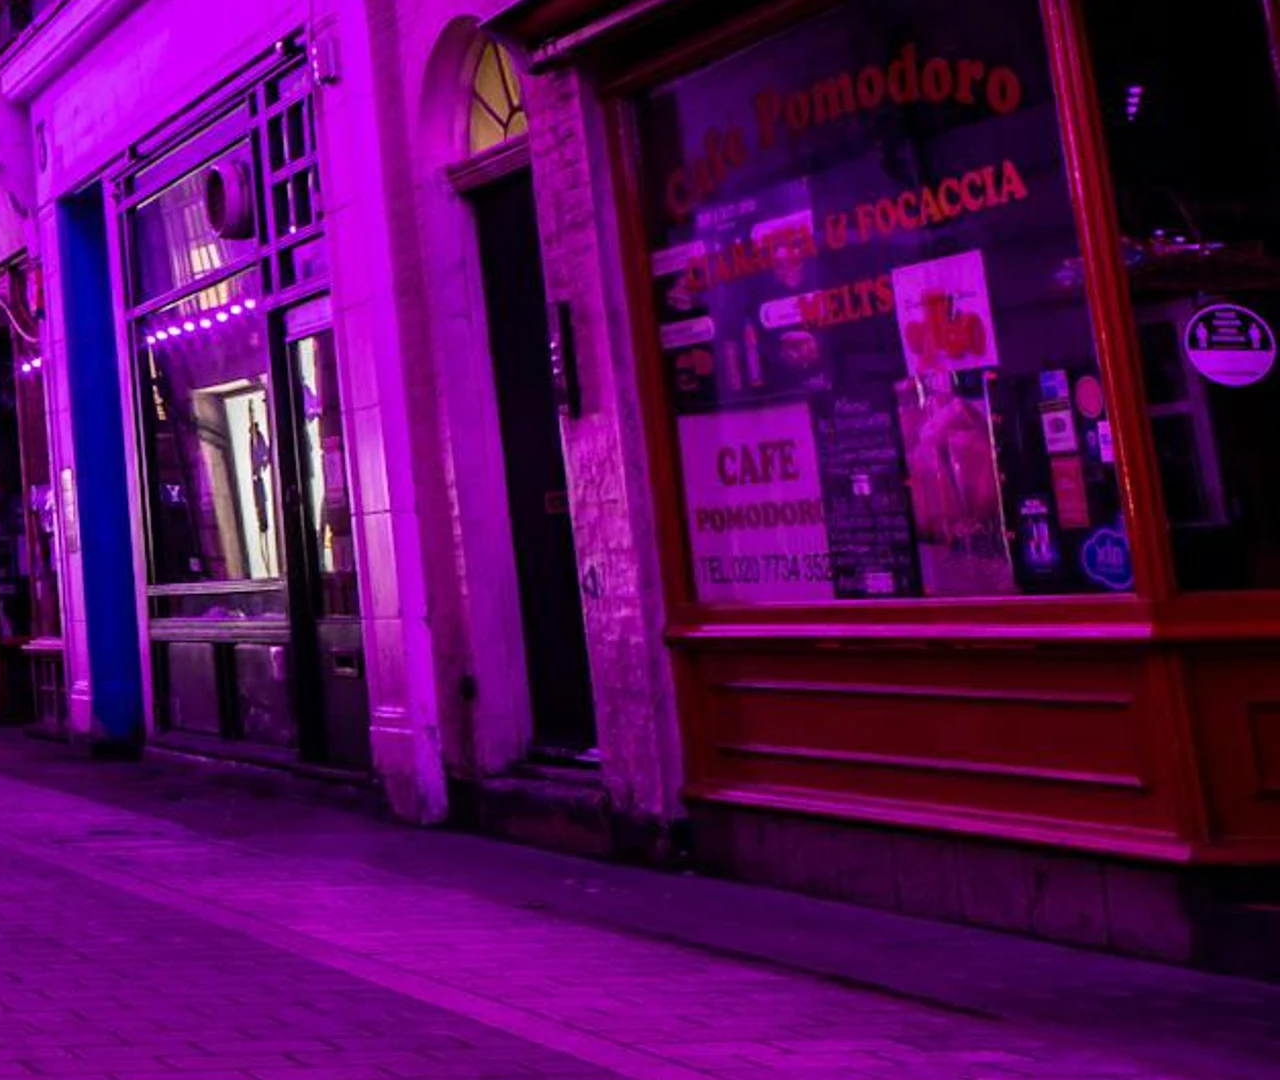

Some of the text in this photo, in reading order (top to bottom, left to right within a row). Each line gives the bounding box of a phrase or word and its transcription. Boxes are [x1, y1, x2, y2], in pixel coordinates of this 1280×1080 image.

[754, 42, 1021, 148] Pomodoro
[856, 159, 1029, 242] FOCACCIA
[798, 273, 893, 329] MELTS
[717, 439, 800, 487] CAFE
